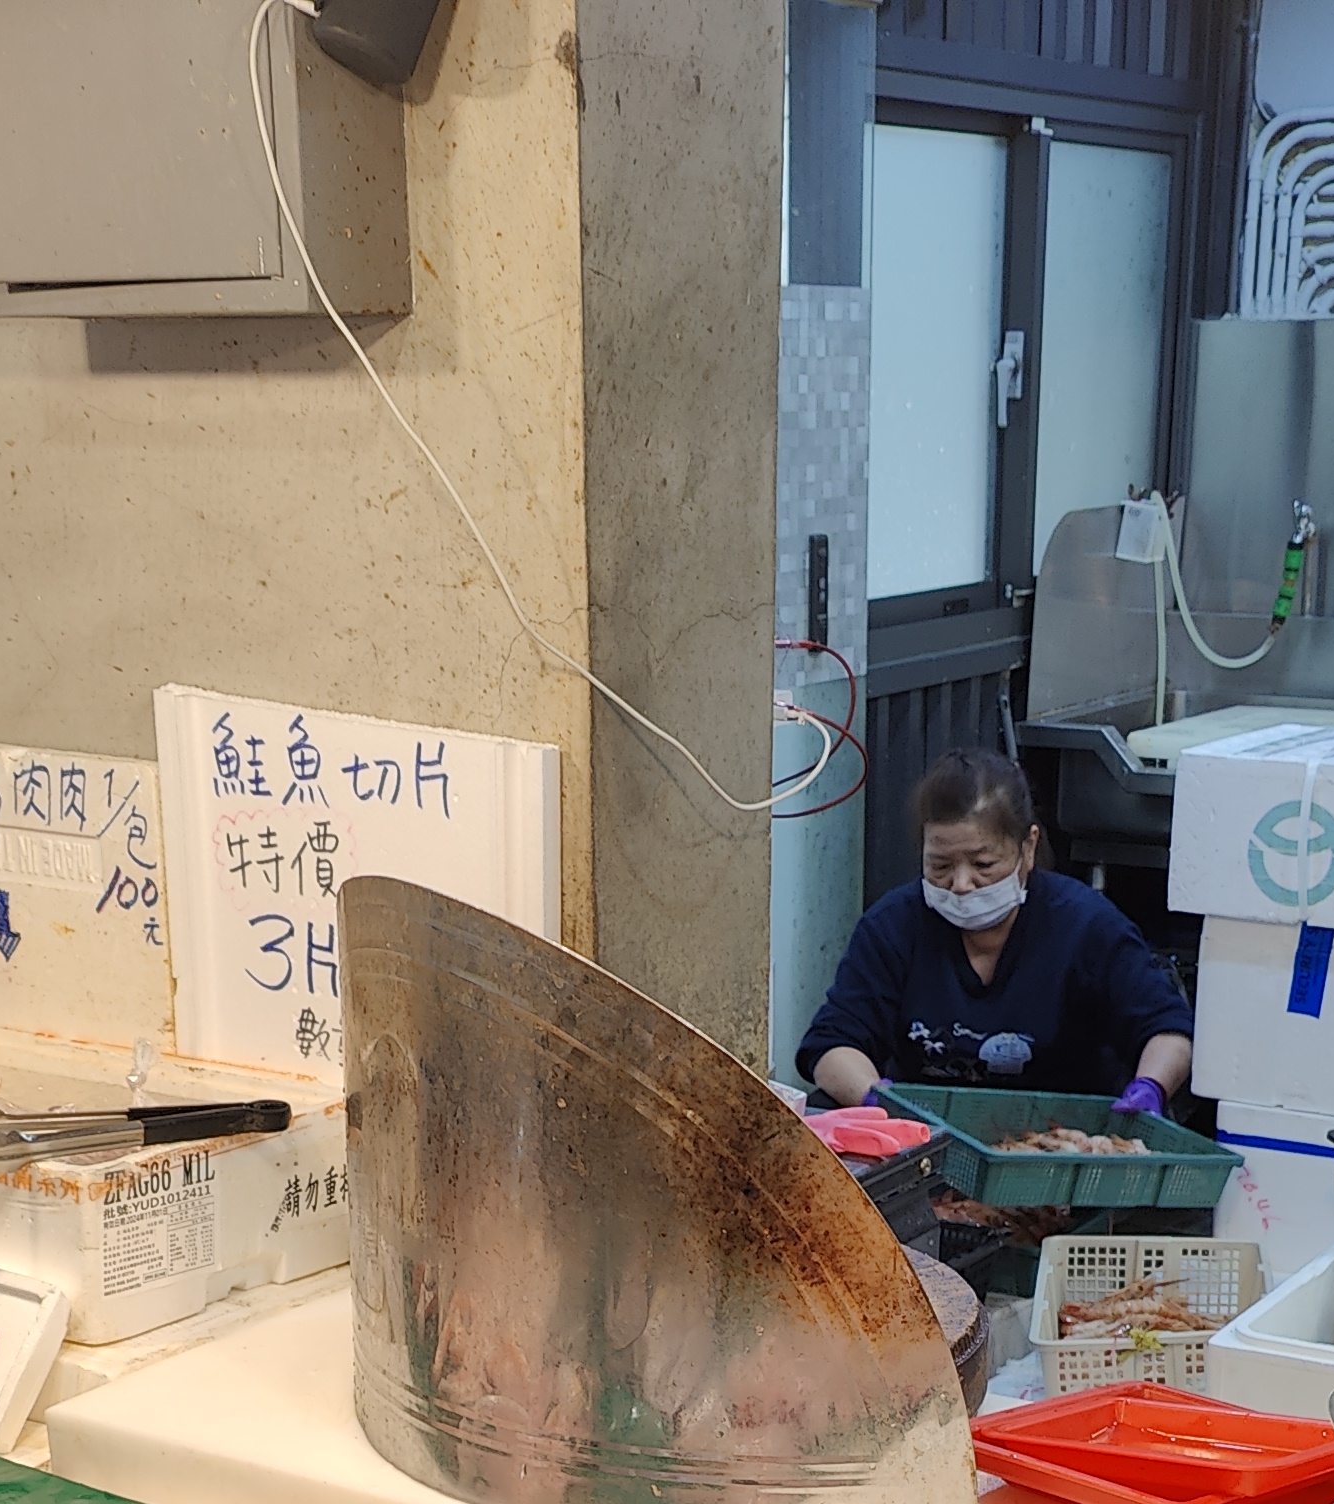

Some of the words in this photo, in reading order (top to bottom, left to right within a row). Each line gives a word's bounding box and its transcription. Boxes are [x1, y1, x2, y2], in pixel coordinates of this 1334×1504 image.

[212, 712, 450, 819] 鮭魚切片
[96, 865, 159, 914] 100
[227, 820, 338, 898] 特價
[143, 917, 164, 946] 元
[245, 914, 339, 998] 3片
[295, 1007, 343, 1067] 數
